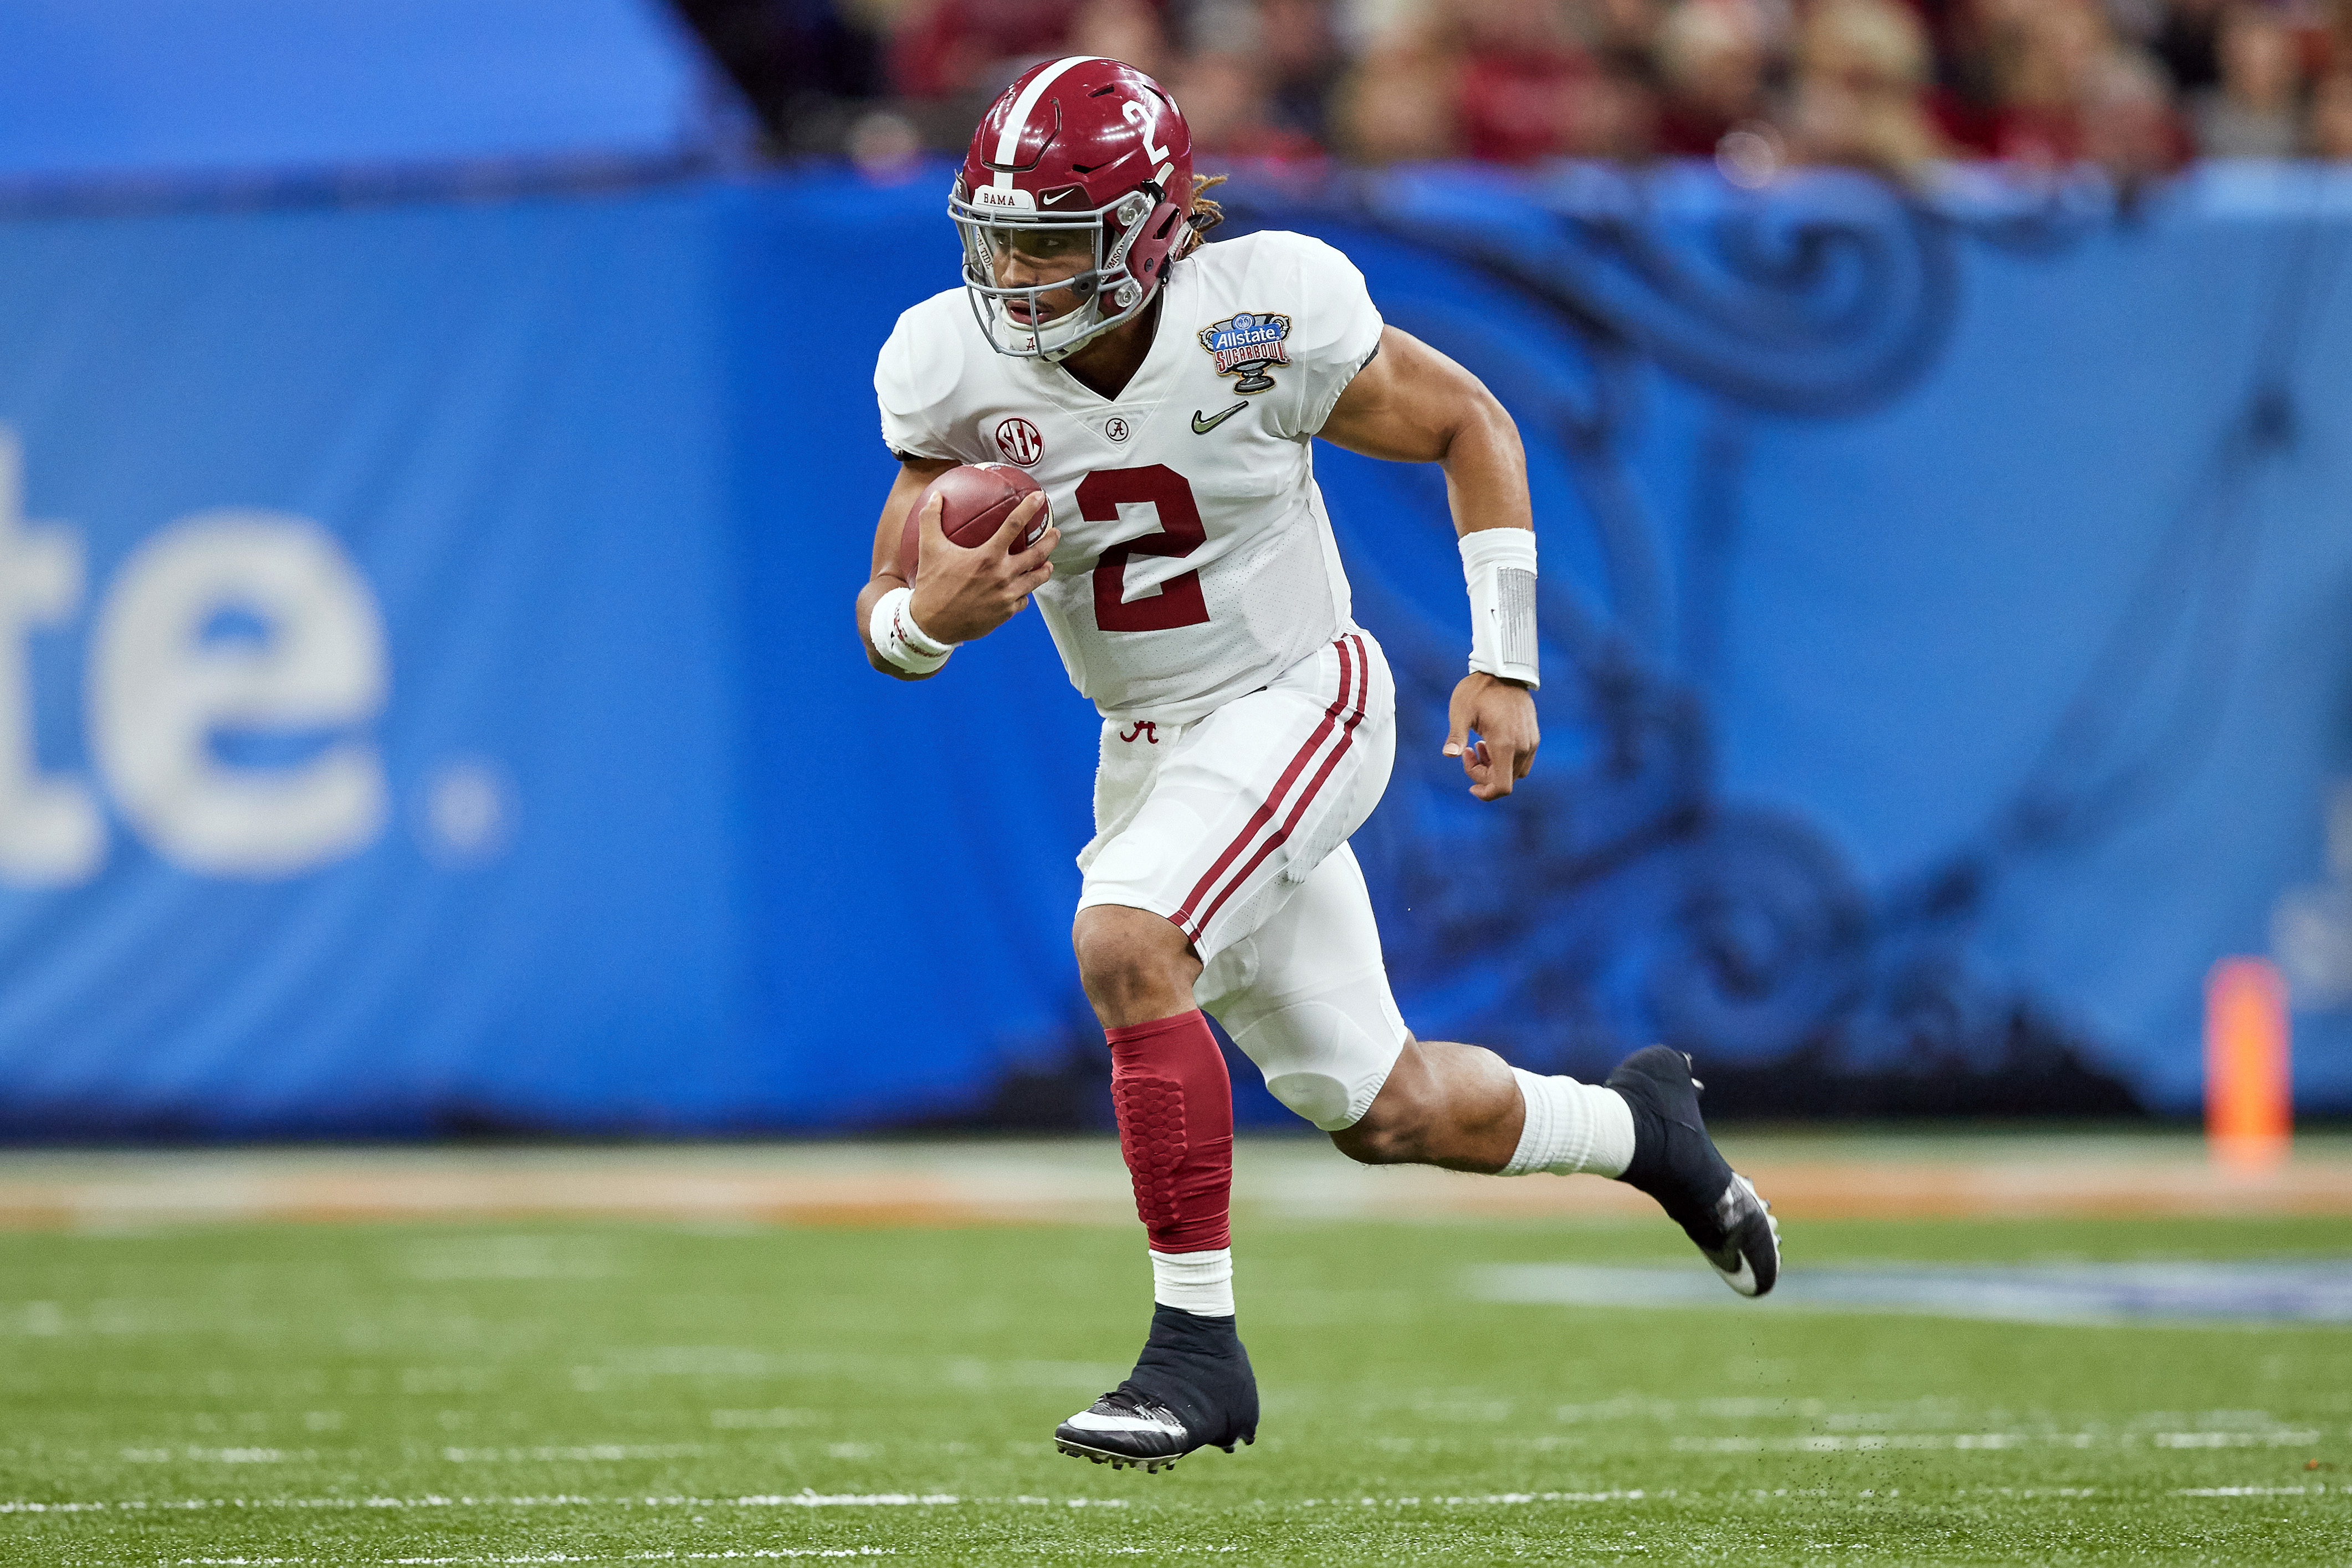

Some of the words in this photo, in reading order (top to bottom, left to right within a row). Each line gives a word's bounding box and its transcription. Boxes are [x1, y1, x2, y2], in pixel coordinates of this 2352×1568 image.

[1121, 100, 1170, 166] 2
[983, 193, 1015, 206] BAMA
[981, 247, 993, 269] TIDE
[1216, 327, 1276, 349] Allstate
[998, 420, 1041, 463] SEC
[1075, 463, 1211, 632] 2
